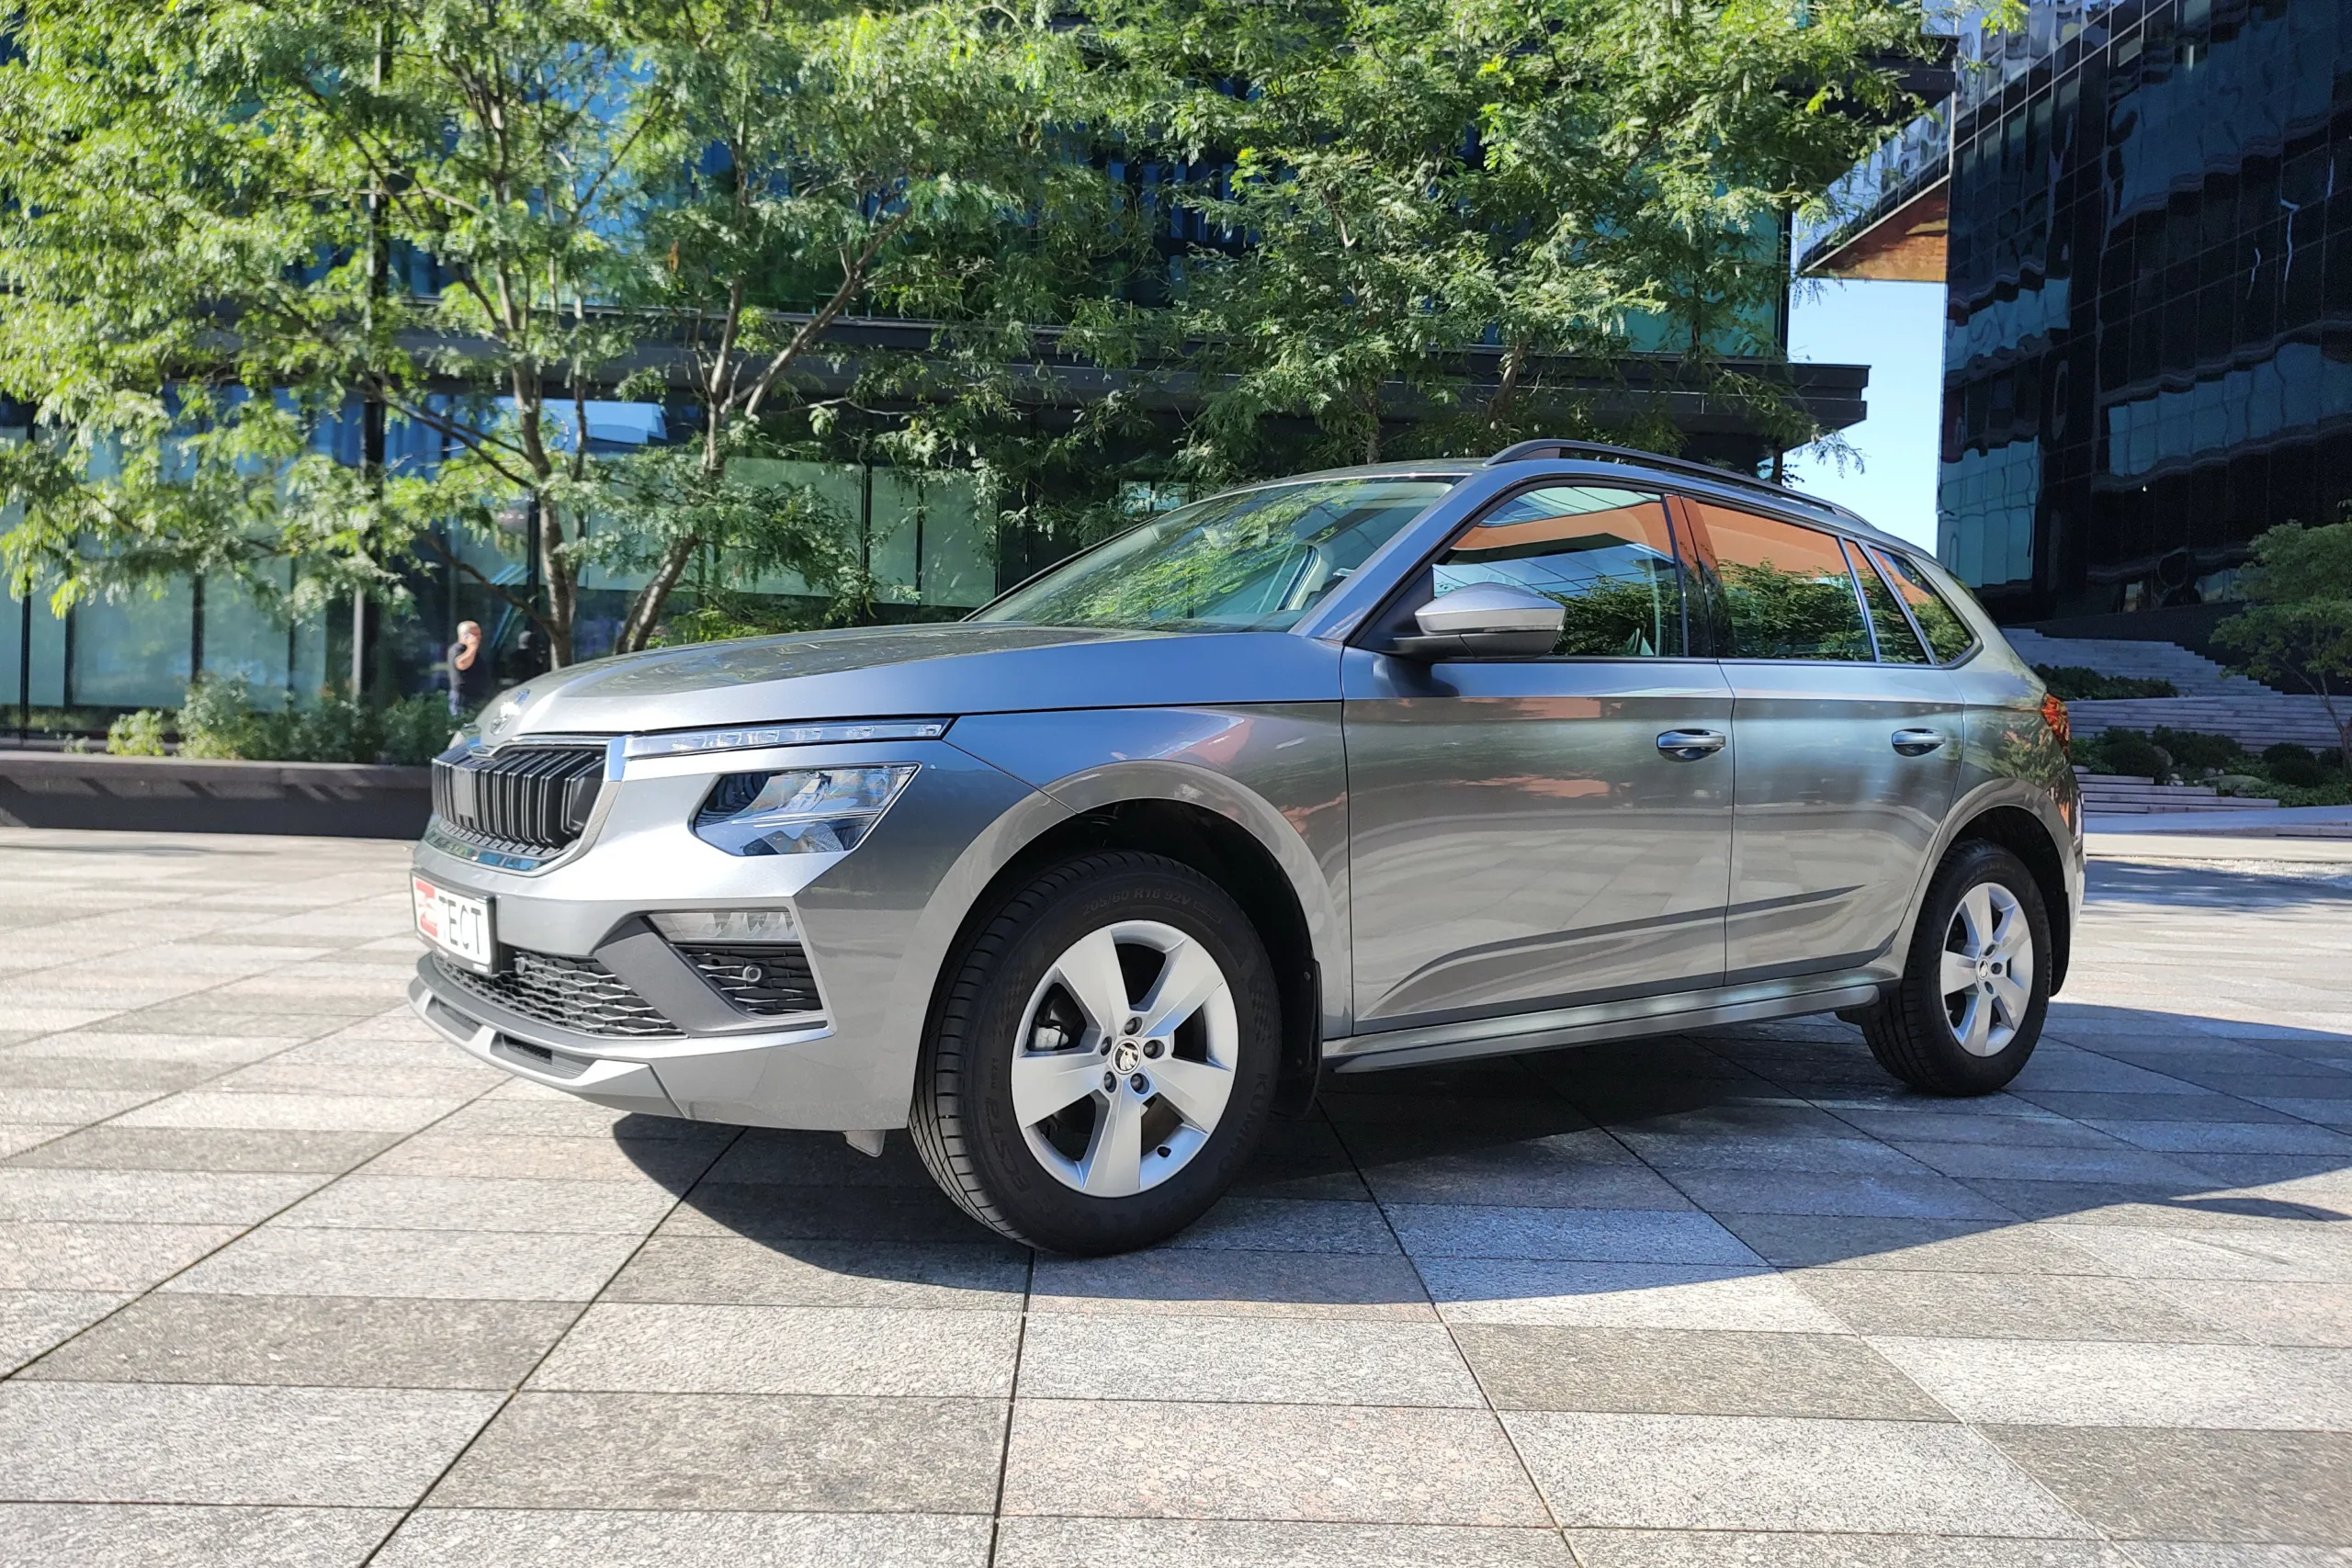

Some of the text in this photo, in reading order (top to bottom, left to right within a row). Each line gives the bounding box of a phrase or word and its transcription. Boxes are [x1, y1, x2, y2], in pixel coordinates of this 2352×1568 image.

[1082, 887, 1191, 917] 205/60 R16 92V
